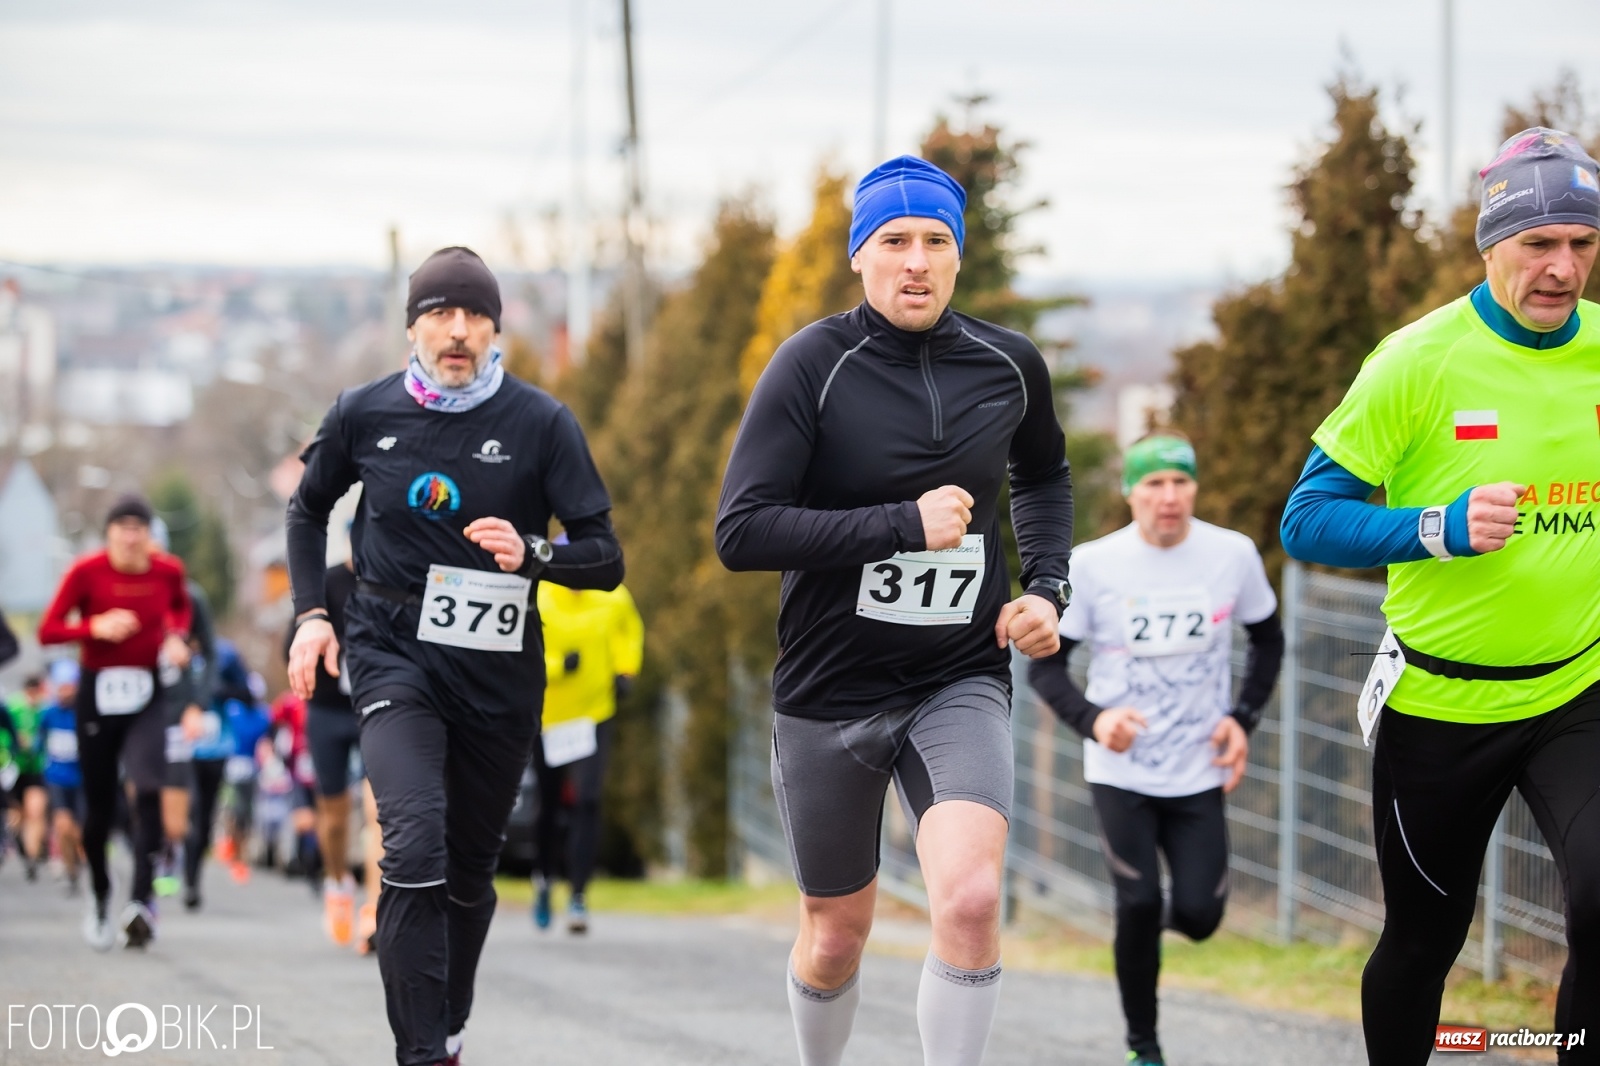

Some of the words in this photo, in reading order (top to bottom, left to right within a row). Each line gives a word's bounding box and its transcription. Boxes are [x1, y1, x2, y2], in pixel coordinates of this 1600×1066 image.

[868, 563, 977, 608] 317
[430, 595, 523, 637] 379
[1132, 611, 1205, 641] 272
